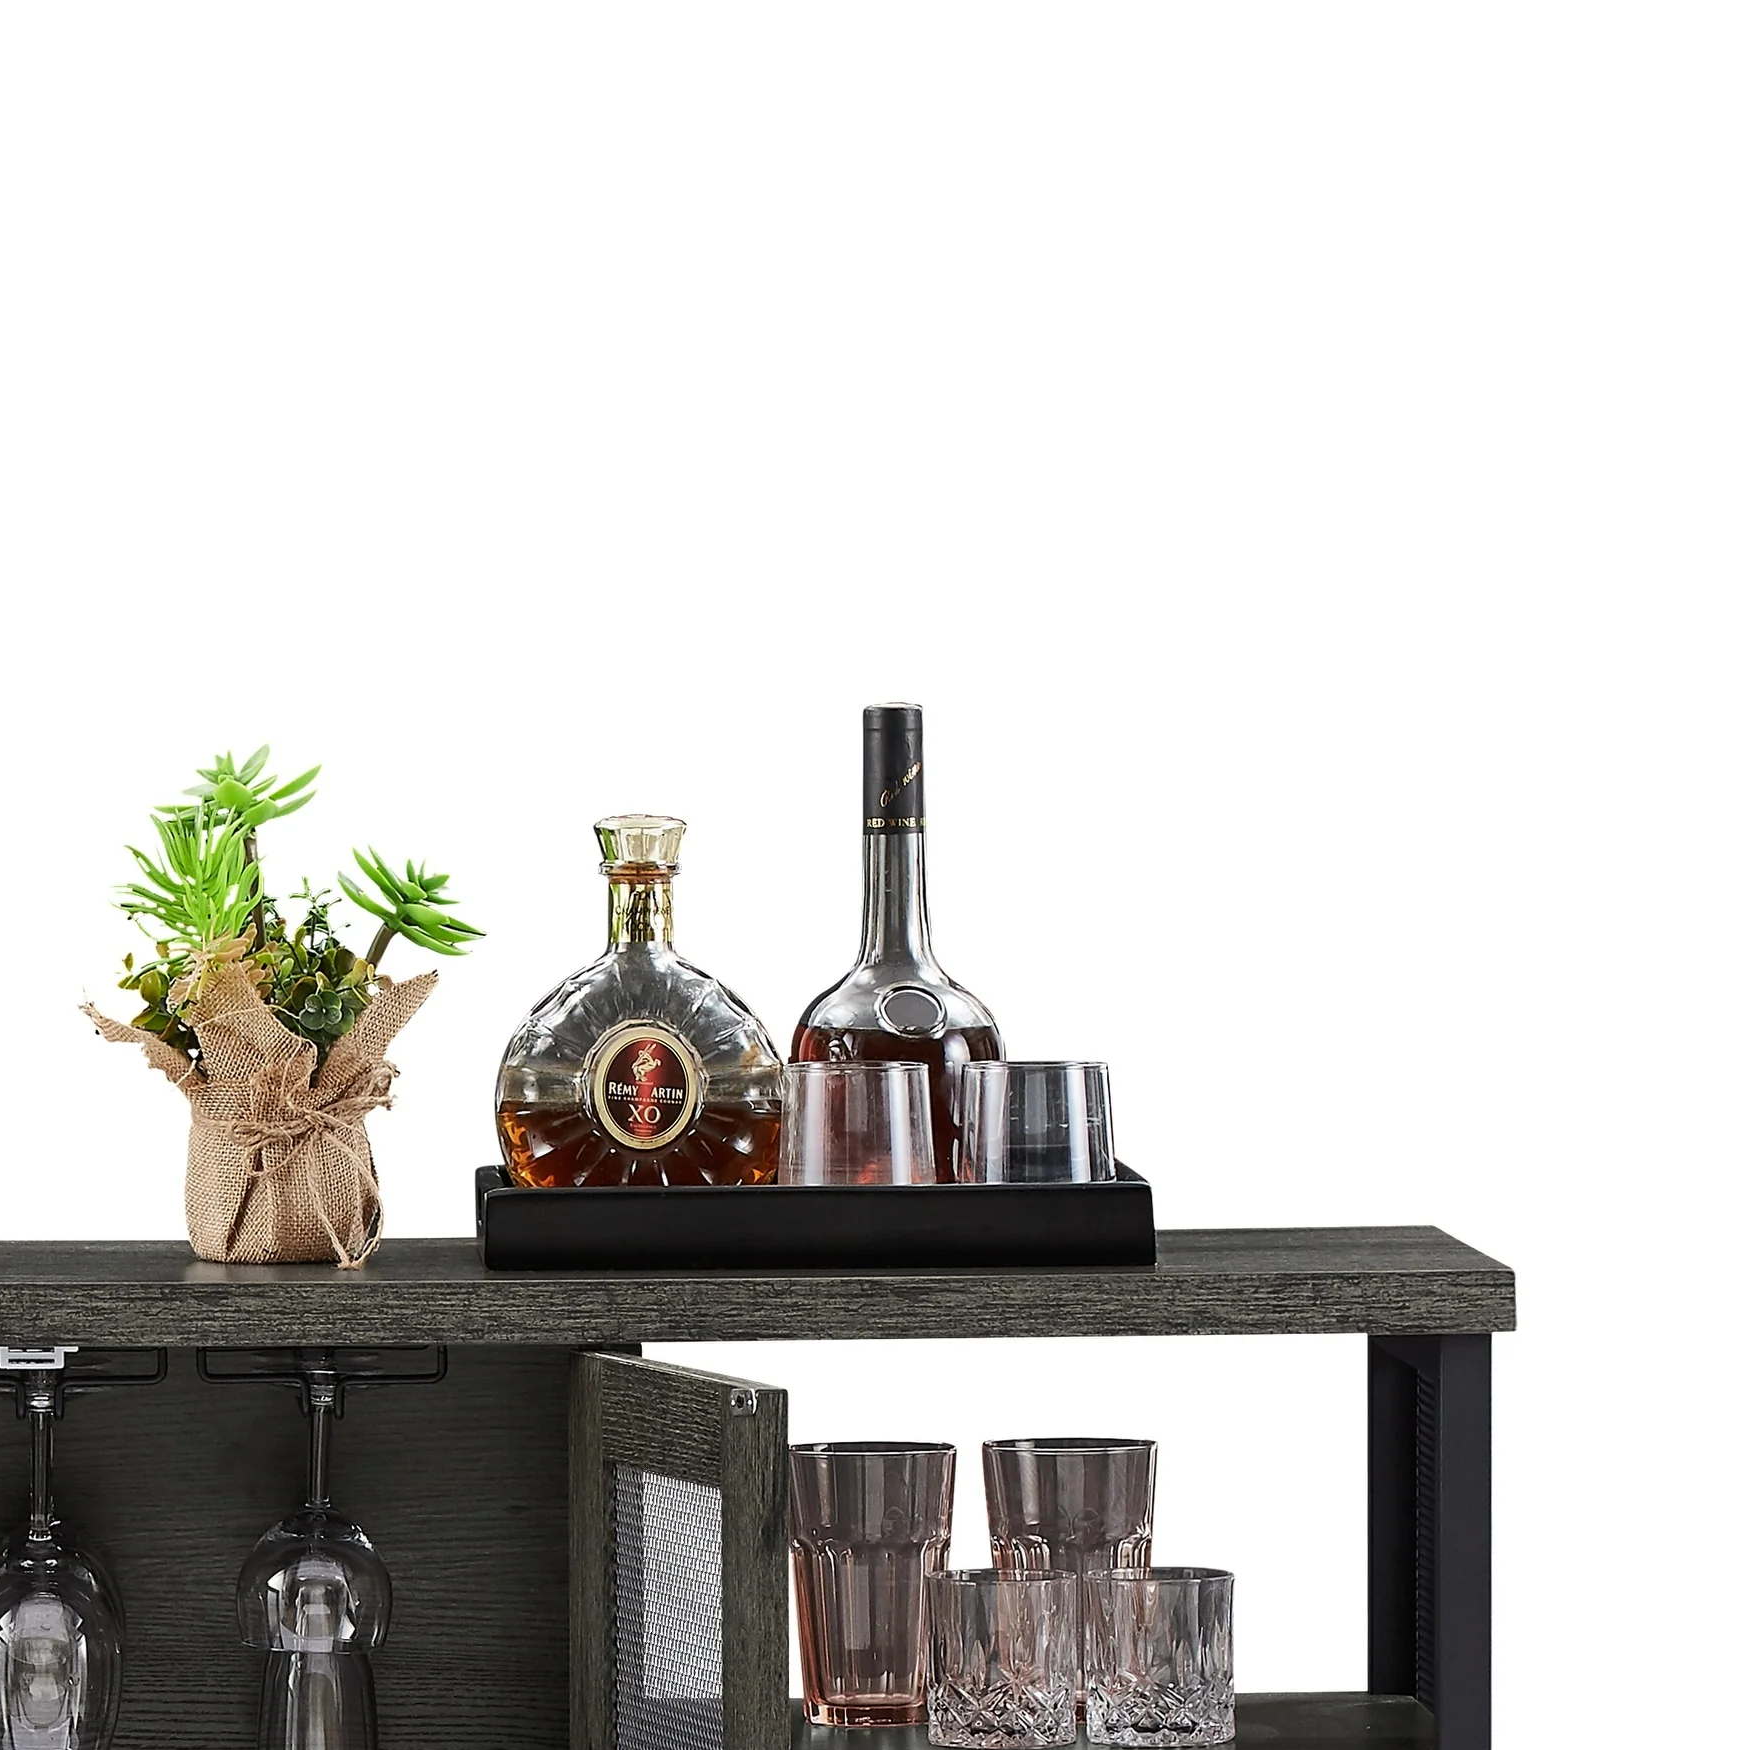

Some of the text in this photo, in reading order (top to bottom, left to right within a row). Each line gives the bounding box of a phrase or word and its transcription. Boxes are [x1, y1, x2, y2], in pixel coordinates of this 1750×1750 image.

[866, 816, 886, 829] RED
[888, 816, 917, 828] WINE
[608, 1080, 639, 1097] RÉMY
[627, 1103, 662, 1124] XO
